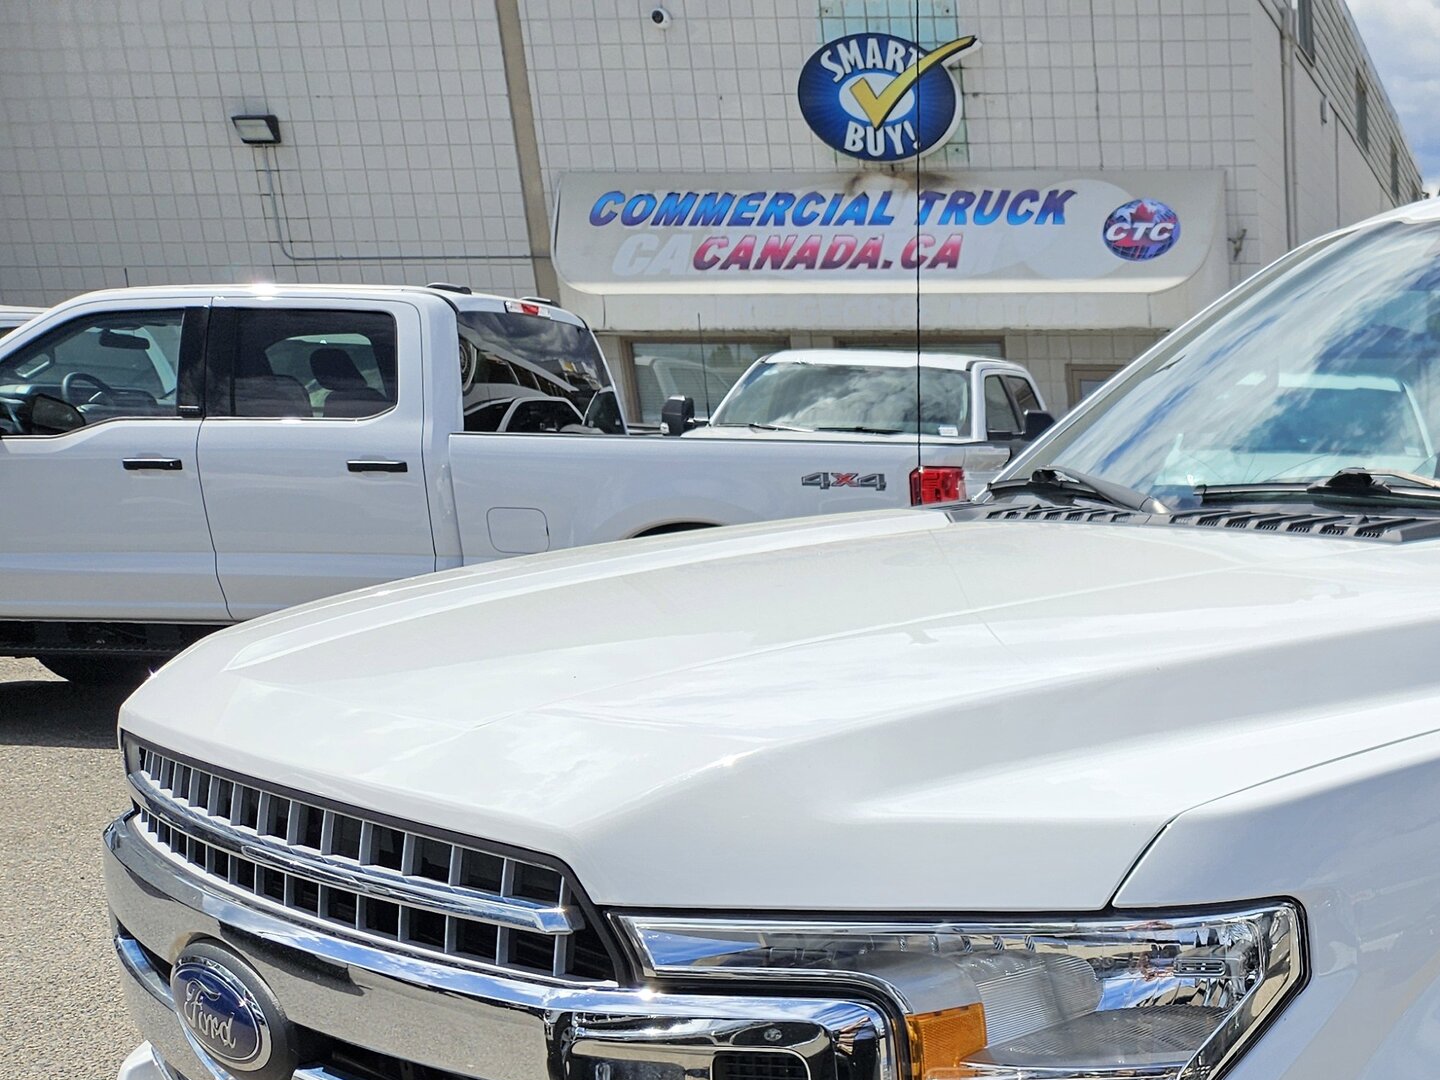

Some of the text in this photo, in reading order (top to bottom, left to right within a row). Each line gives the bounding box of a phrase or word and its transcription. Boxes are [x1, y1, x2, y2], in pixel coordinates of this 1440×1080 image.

[820, 38, 925, 83] SMART
[844, 120, 921, 157] BUY!
[588, 188, 1079, 228] COMMERCIAL TRUCK
[1106, 222, 1175, 241] CTC
[692, 232, 964, 272] CANADA.CA
